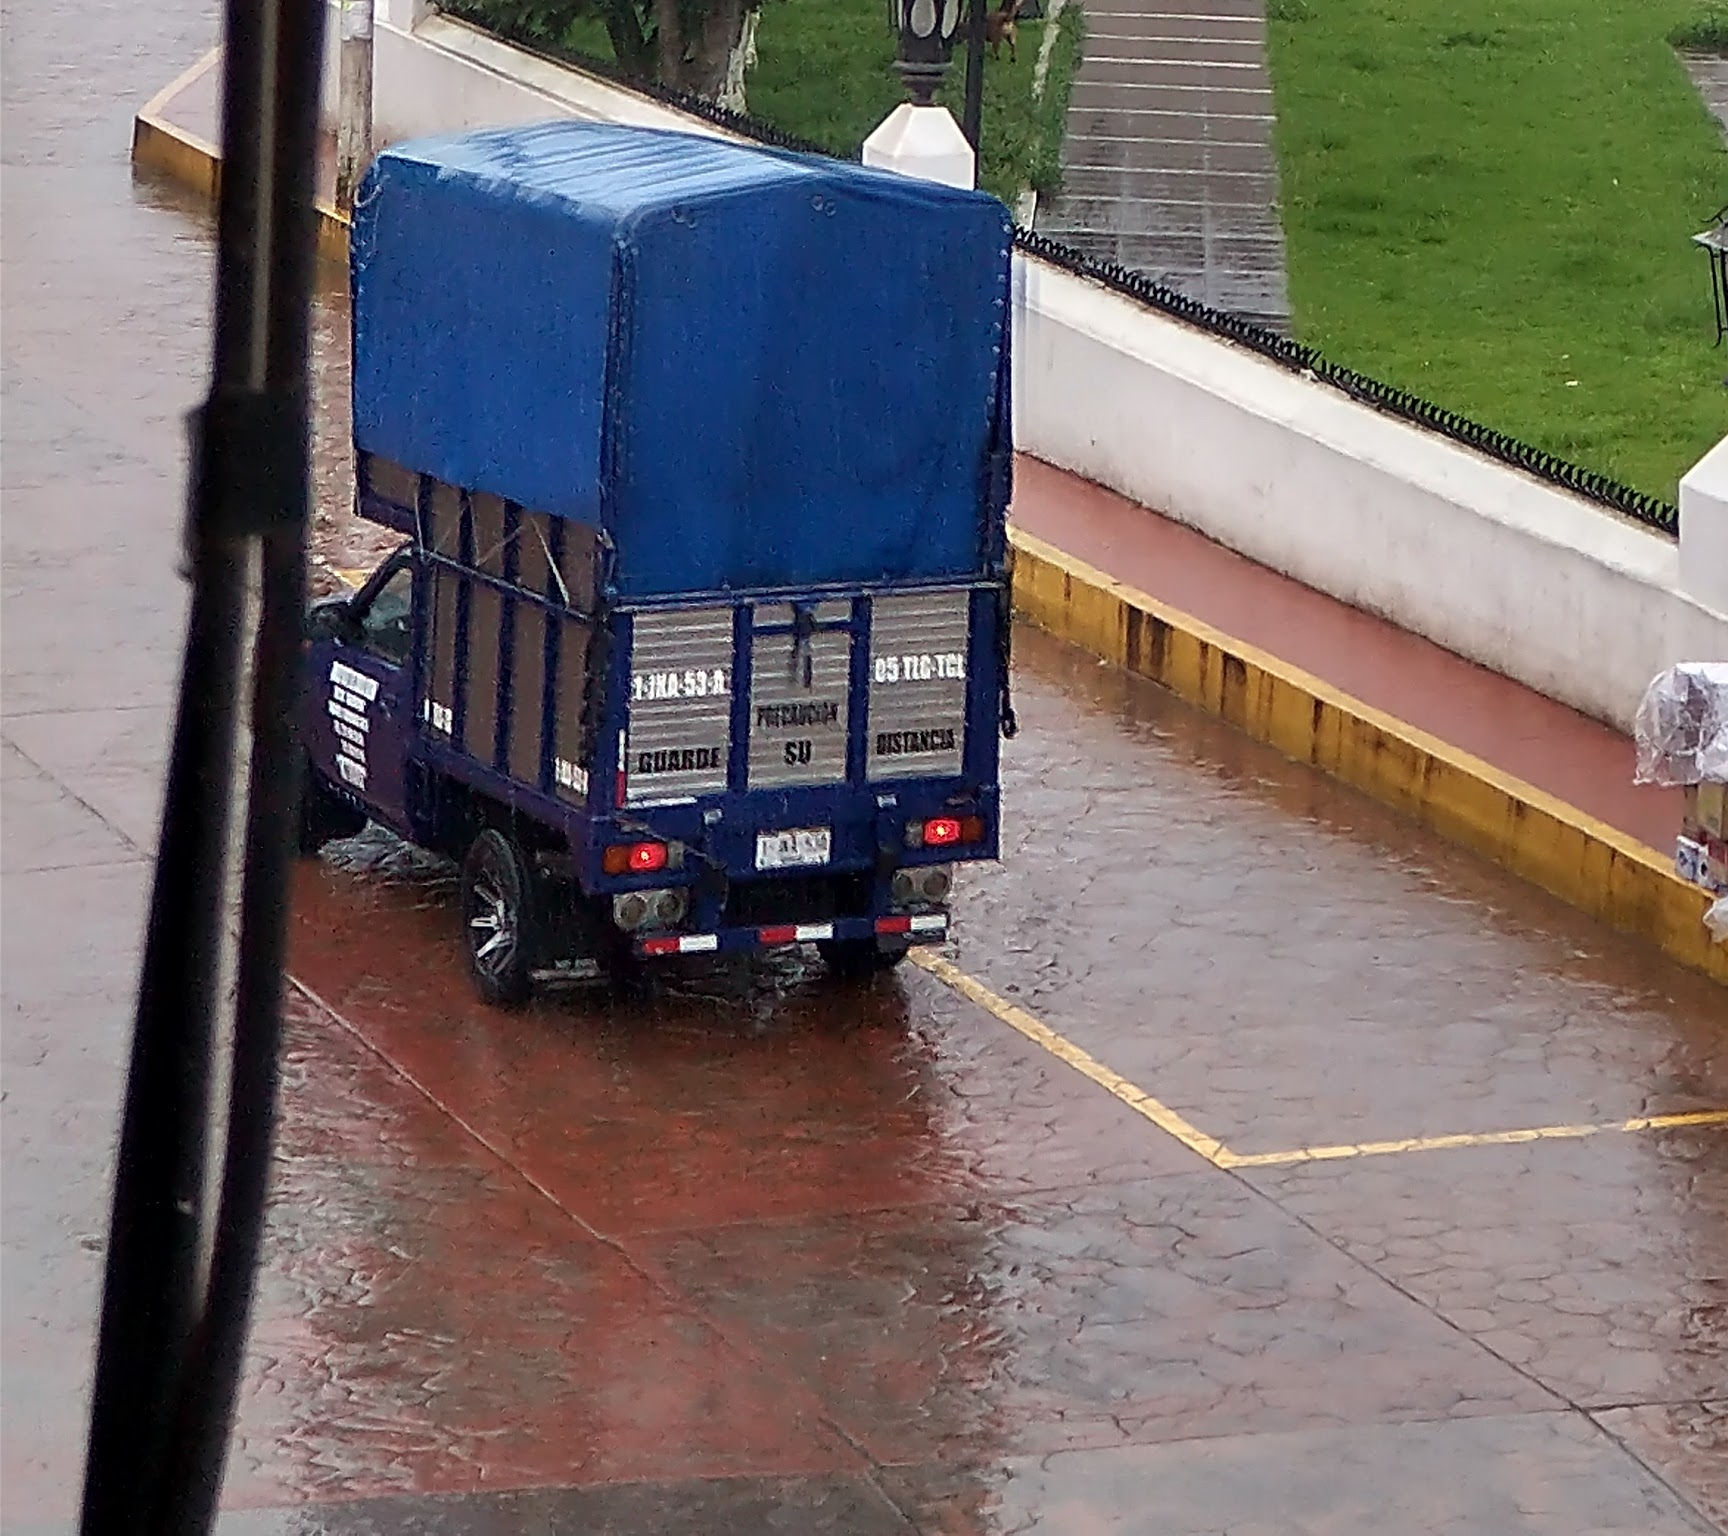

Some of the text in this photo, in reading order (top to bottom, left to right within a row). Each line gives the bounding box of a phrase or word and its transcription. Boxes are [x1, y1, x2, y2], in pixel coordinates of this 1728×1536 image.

[639, 729, 955, 773] GUARDE SU DISTANCIA
